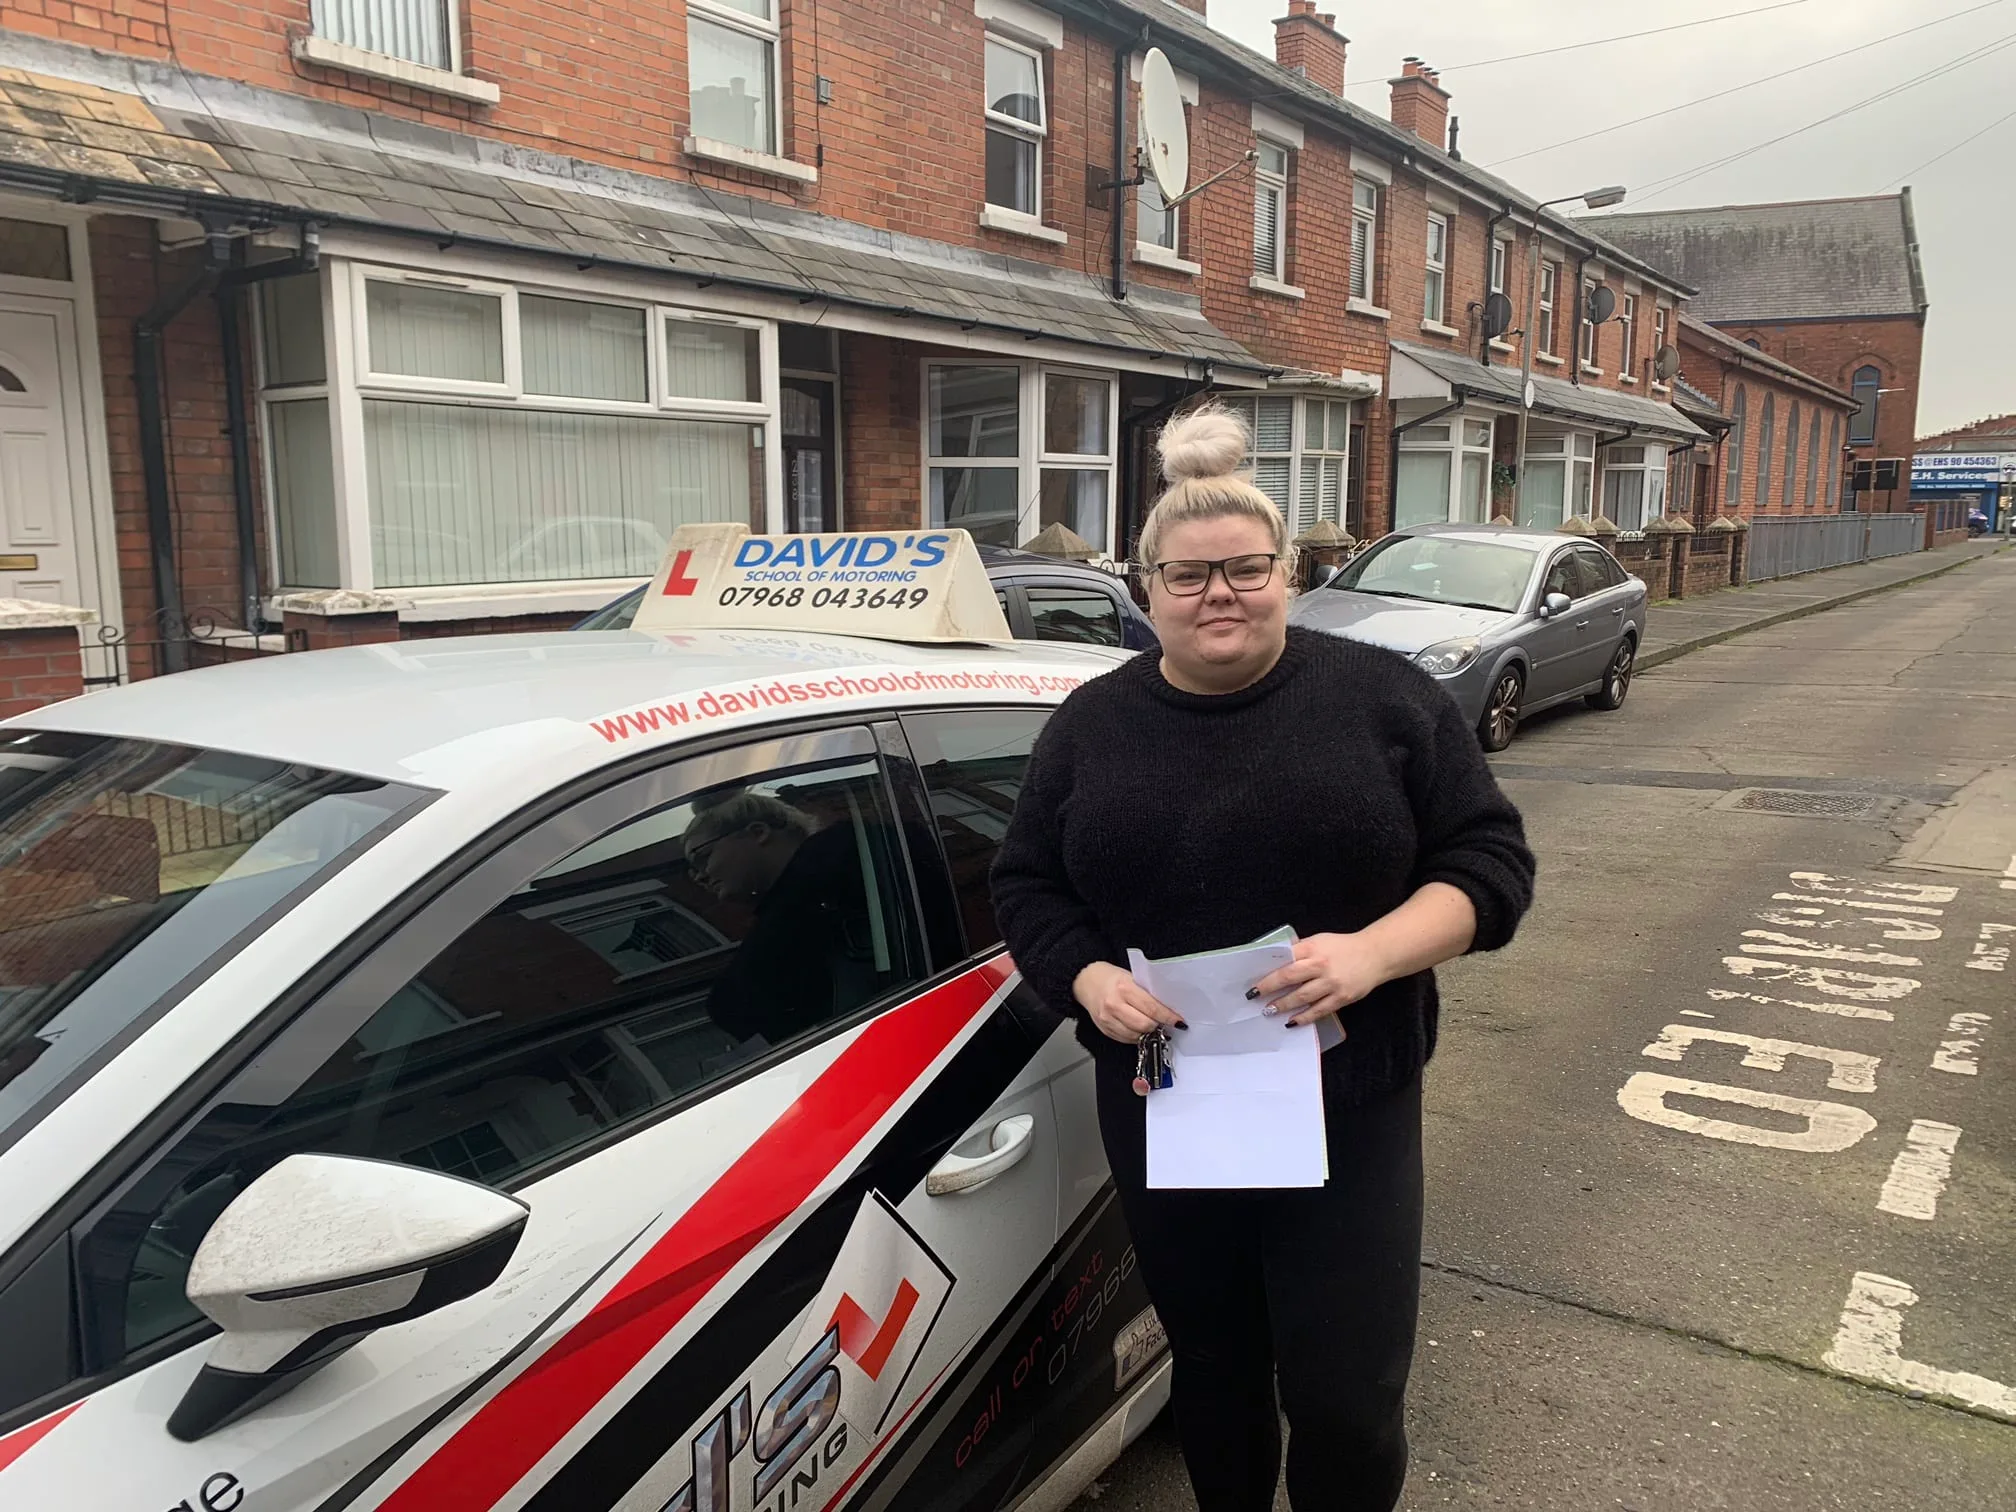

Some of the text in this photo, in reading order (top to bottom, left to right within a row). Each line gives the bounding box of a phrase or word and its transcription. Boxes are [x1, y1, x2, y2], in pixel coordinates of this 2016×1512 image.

[1963, 456, 1997, 465] 454363
[733, 534, 950, 569] DAVID'S
[662, 549, 699, 596] L
[743, 570, 917, 583] SCHOOL OF MOTORING
[717, 586, 930, 611] 07968 043649
[955, 1250, 1105, 1469] call or text
